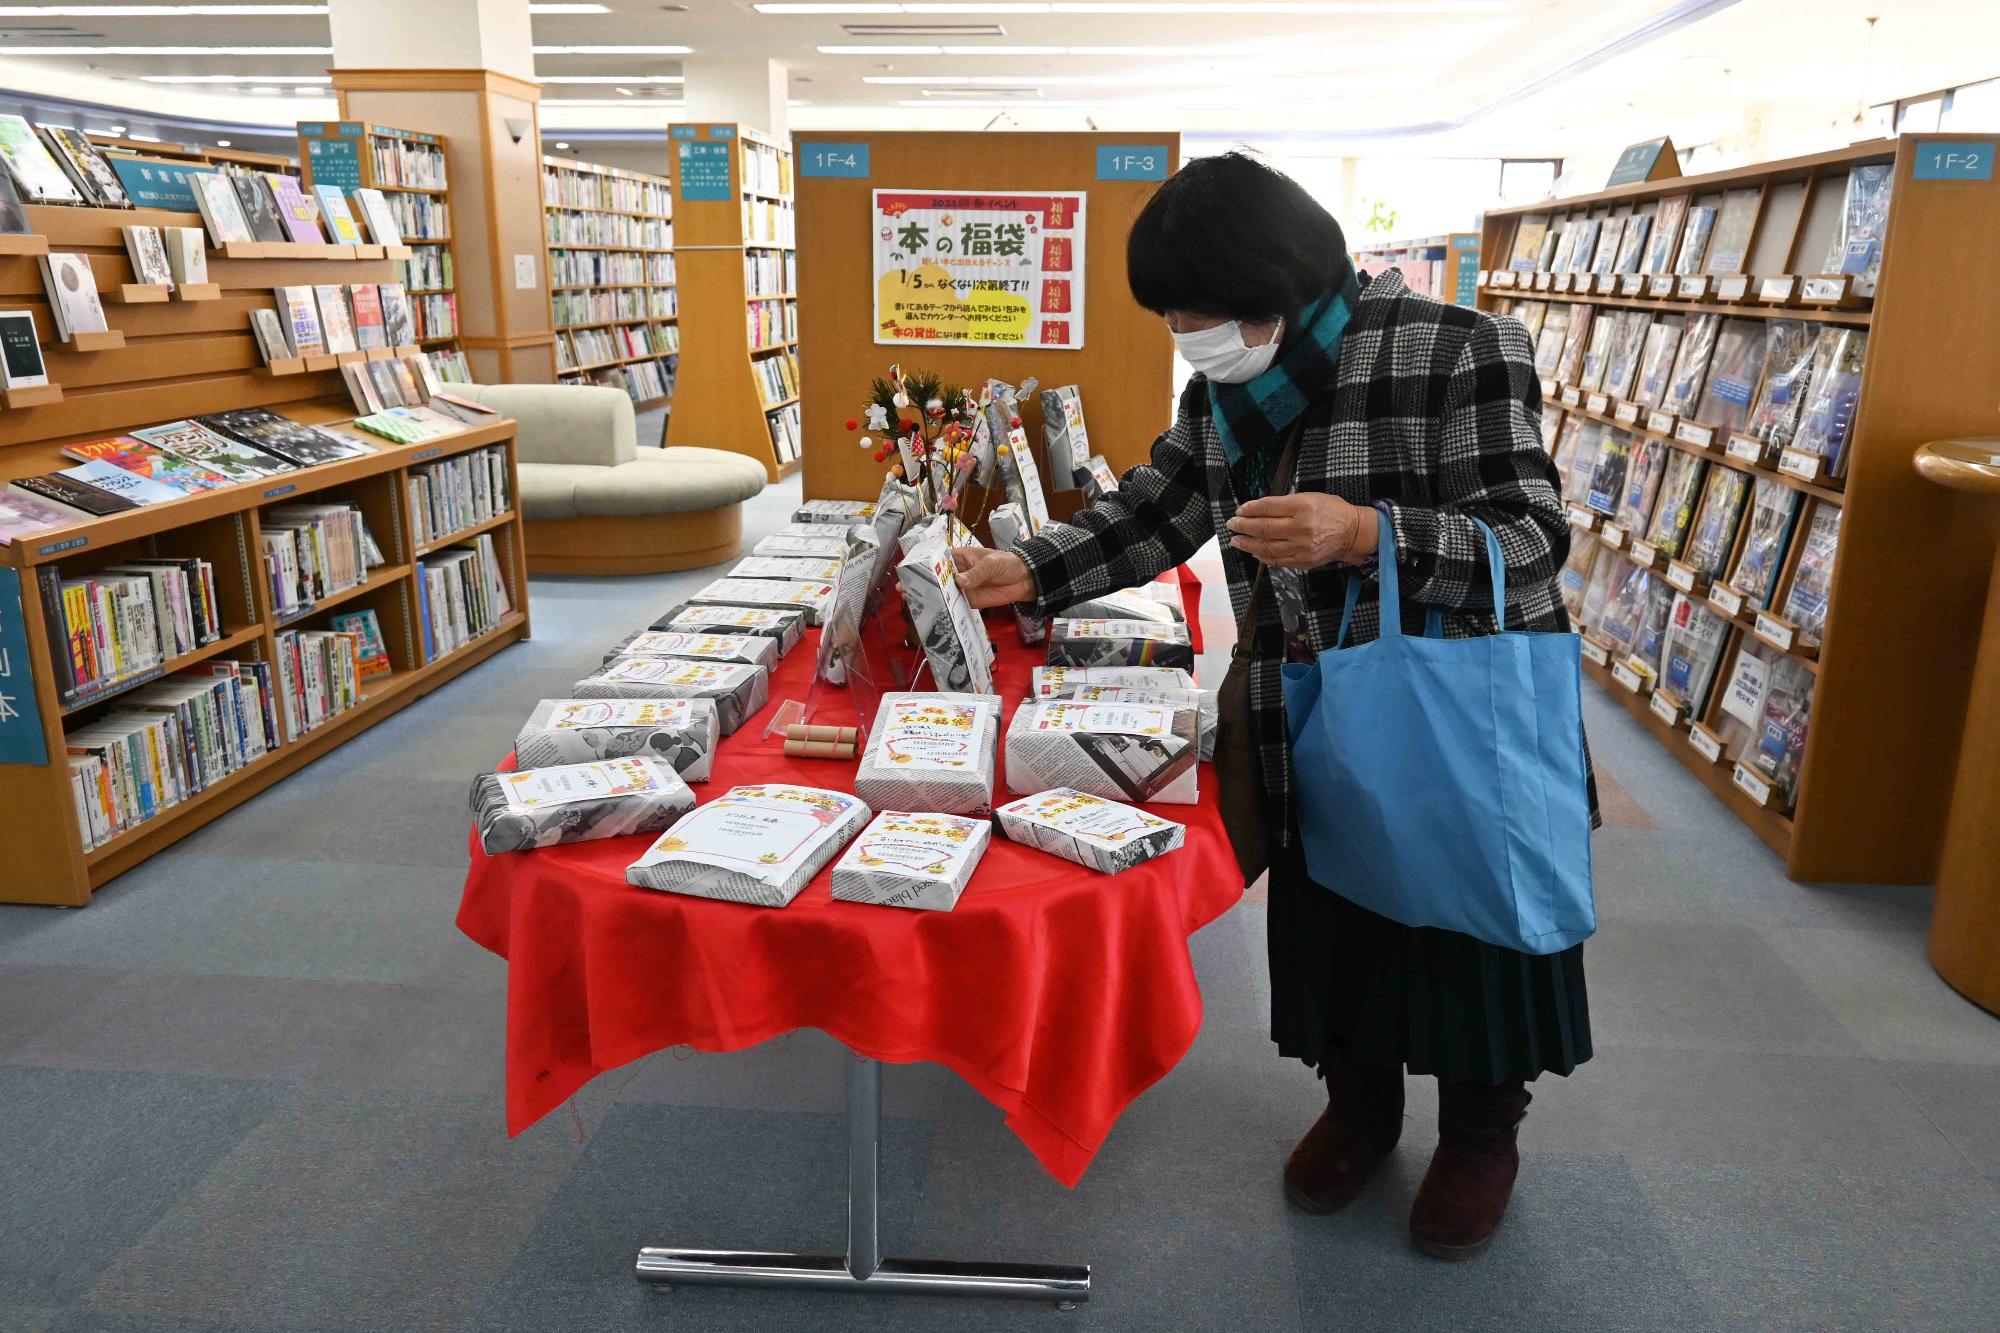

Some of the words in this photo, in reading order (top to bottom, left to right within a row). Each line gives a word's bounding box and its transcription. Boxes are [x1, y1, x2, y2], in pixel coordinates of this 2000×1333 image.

[815, 152, 857, 168] 1F-4
[1112, 156, 1155, 171] 1F-3
[1934, 153, 1979, 170] 1F-2
[898, 221, 1025, 256] 本の福袋
[905, 311, 1017, 322] 選んでカウンターへお持ちください
[899, 715, 970, 727] 本の福袋
[882, 824, 962, 839] 本の福袋
